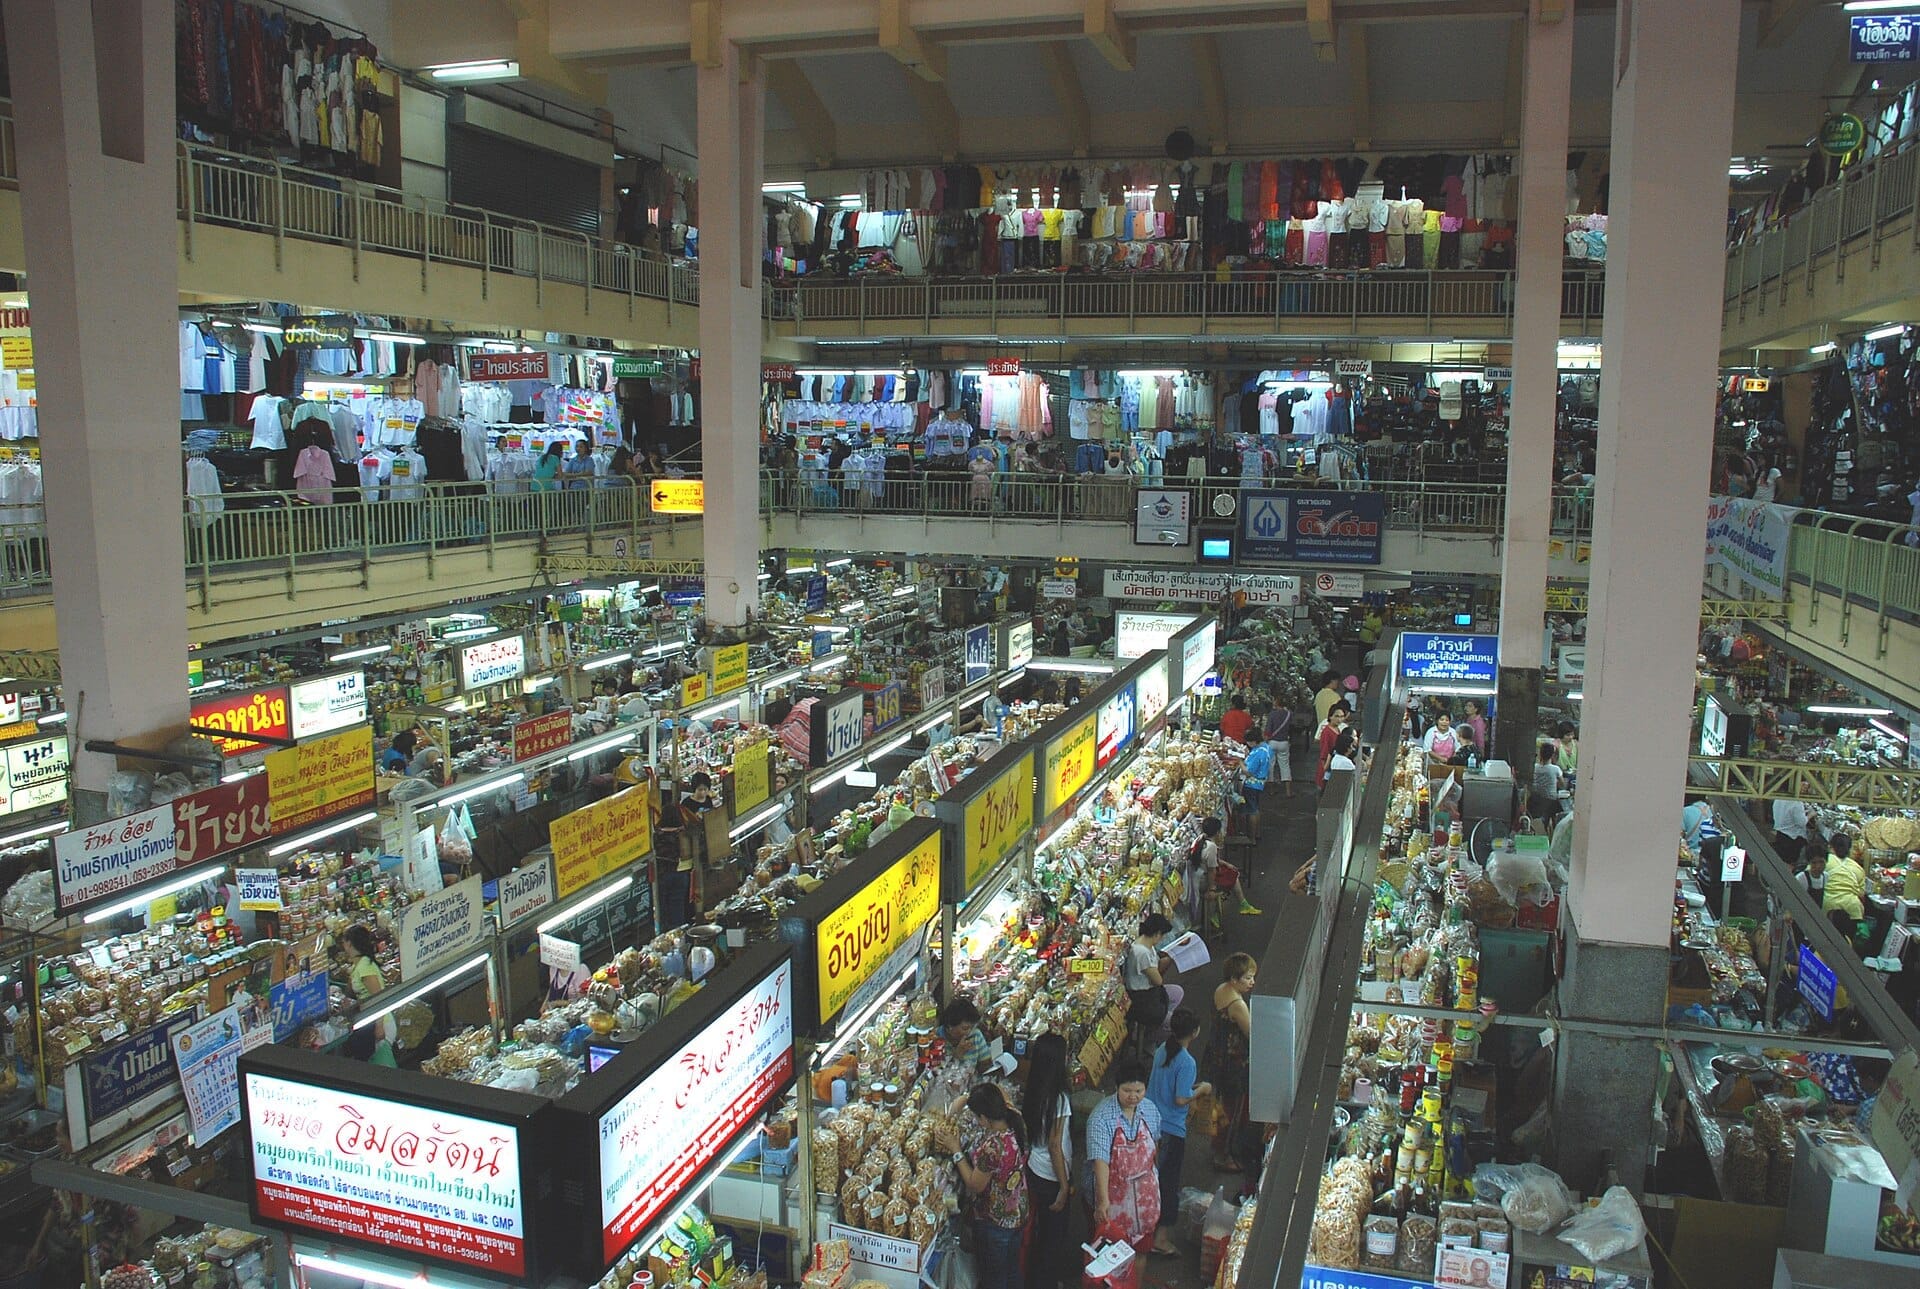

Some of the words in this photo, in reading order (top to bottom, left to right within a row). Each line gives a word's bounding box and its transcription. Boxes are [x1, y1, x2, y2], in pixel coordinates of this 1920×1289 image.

[487, 355, 545, 375] ไทยประสิทธิ์
[1124, 584, 1165, 597] ผักสด
[827, 708, 861, 757] ป้าย่น
[84, 828, 114, 851] ร้าน
[120, 816, 158, 842] อ้อย
[175, 785, 270, 862] ป้าย่น
[503, 863, 547, 904] ร้านโชคดี
[122, 1041, 167, 1081] ป้าย่น
[263, 1109, 323, 1141] หมูยอ
[336, 1104, 510, 1177] วิมลรัตน์
[256, 1140, 371, 1177] หมูยอพริกไทยดำ
[378, 1161, 516, 1208] เจ้าแรกในเชียงใหม่
[268, 1166, 292, 1181] สะอาด
[296, 1172, 330, 1190] ปลอดภัย
[492, 1215, 514, 1230] GMP
[880, 1253, 898, 1265] 100
